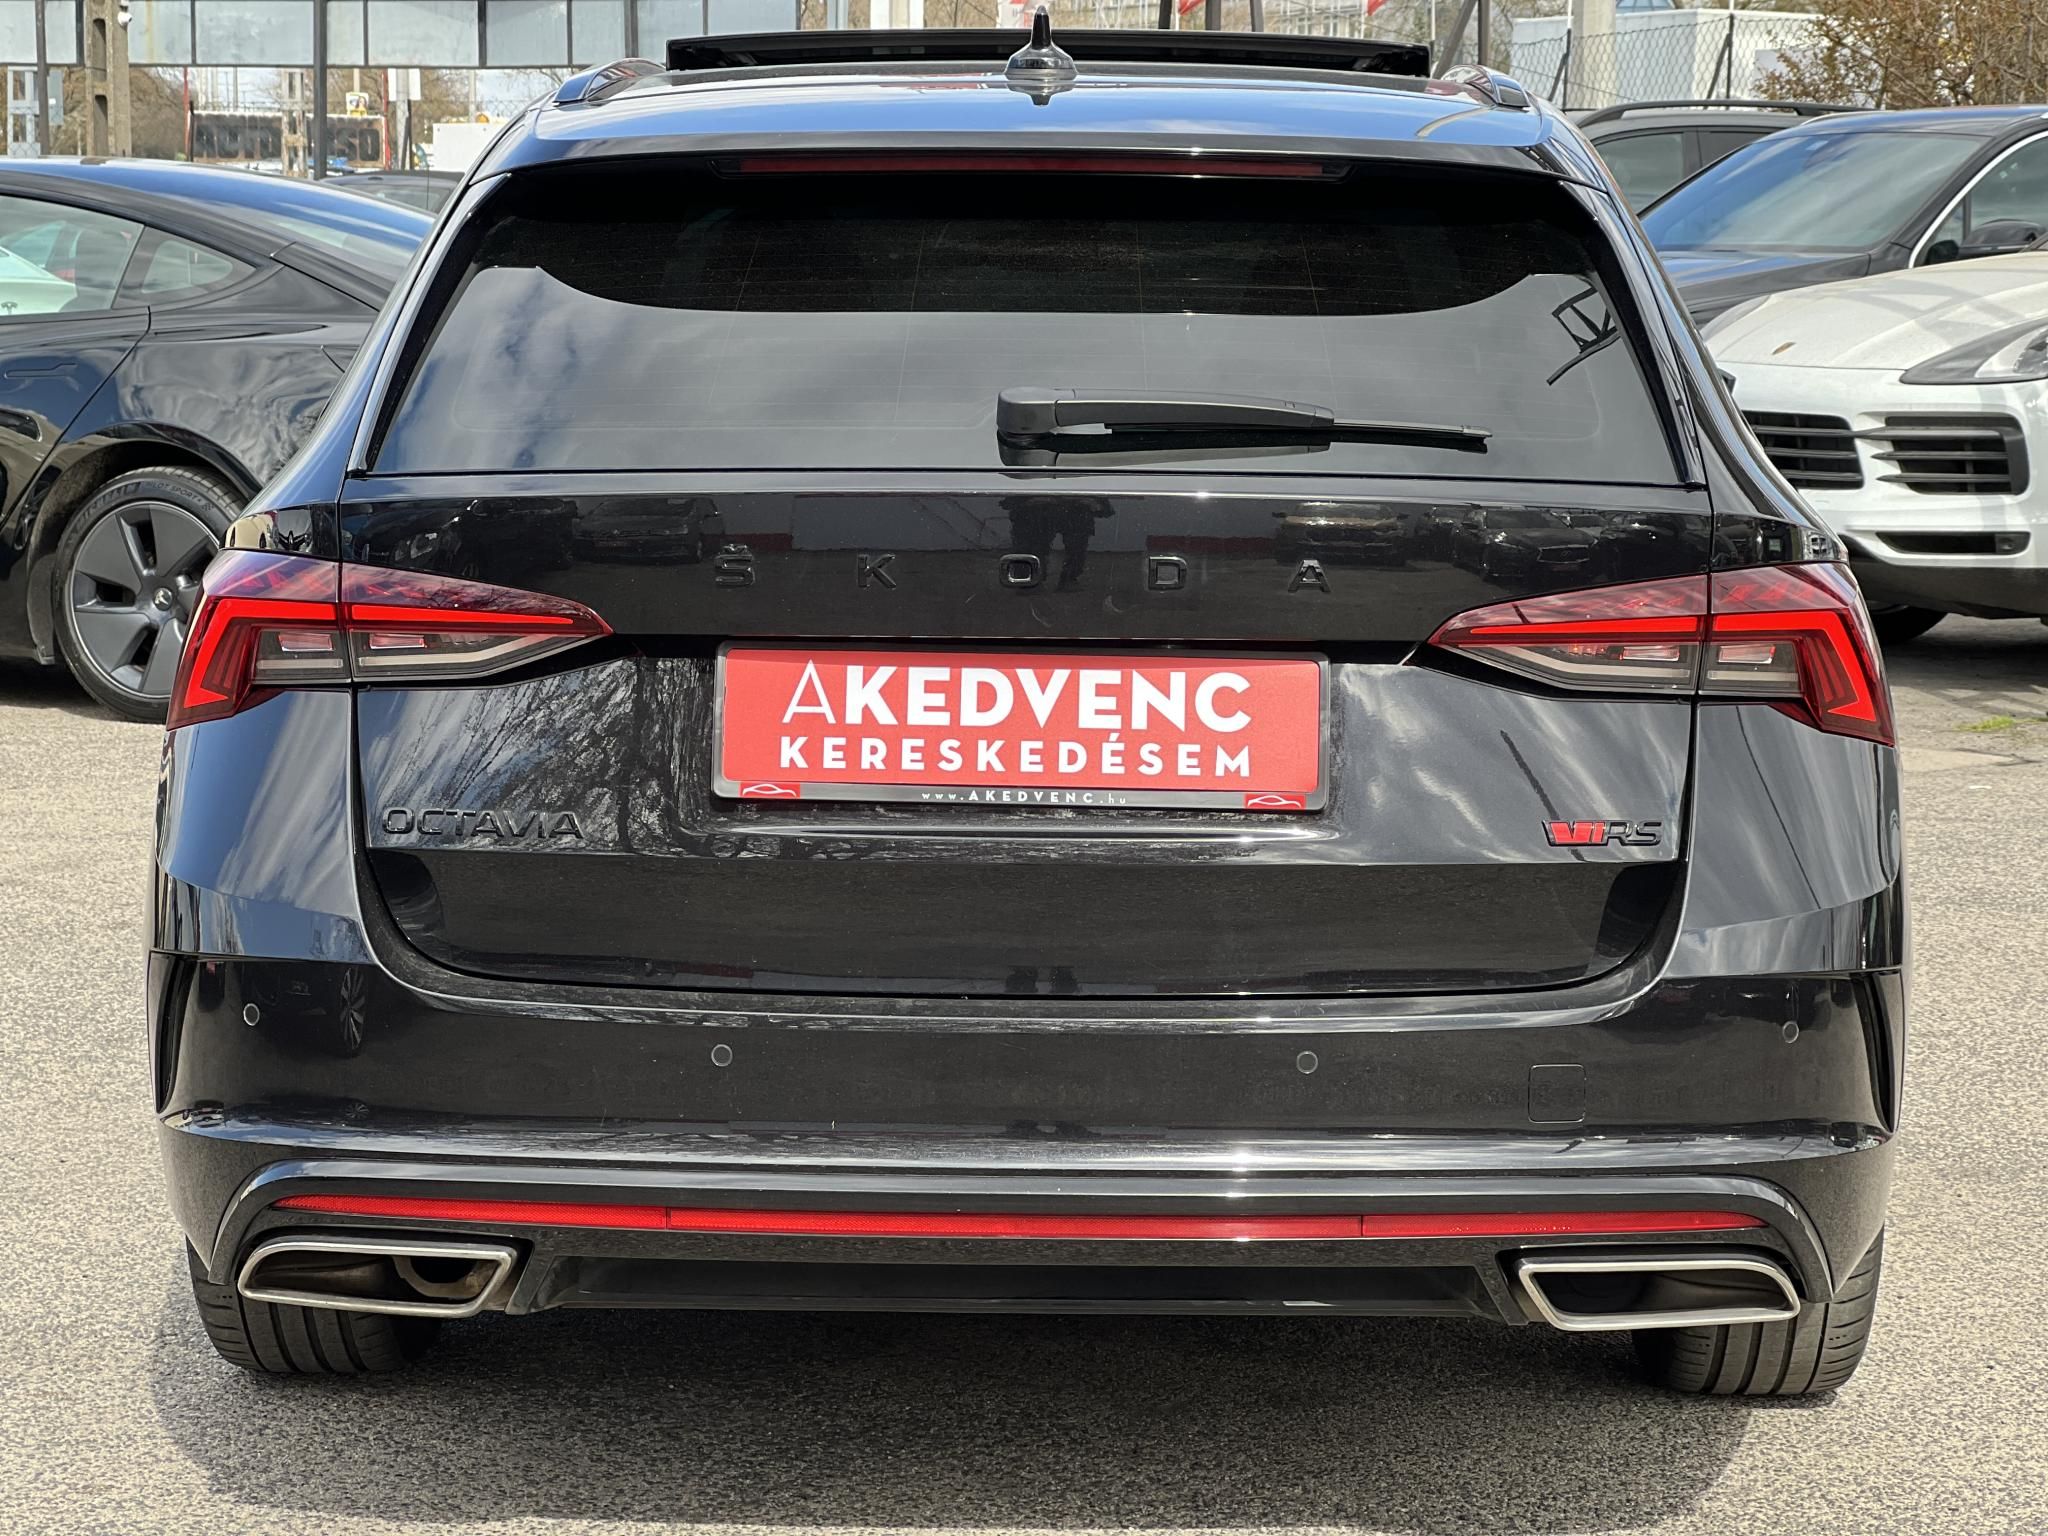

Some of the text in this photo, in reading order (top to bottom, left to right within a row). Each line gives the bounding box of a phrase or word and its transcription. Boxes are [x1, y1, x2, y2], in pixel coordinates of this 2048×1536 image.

[779, 732, 1252, 778] KERESKEDÉSEM
[921, 790, 1127, 805] www.AKEDVENC.hu
[382, 806, 585, 839] OCTAVIA
